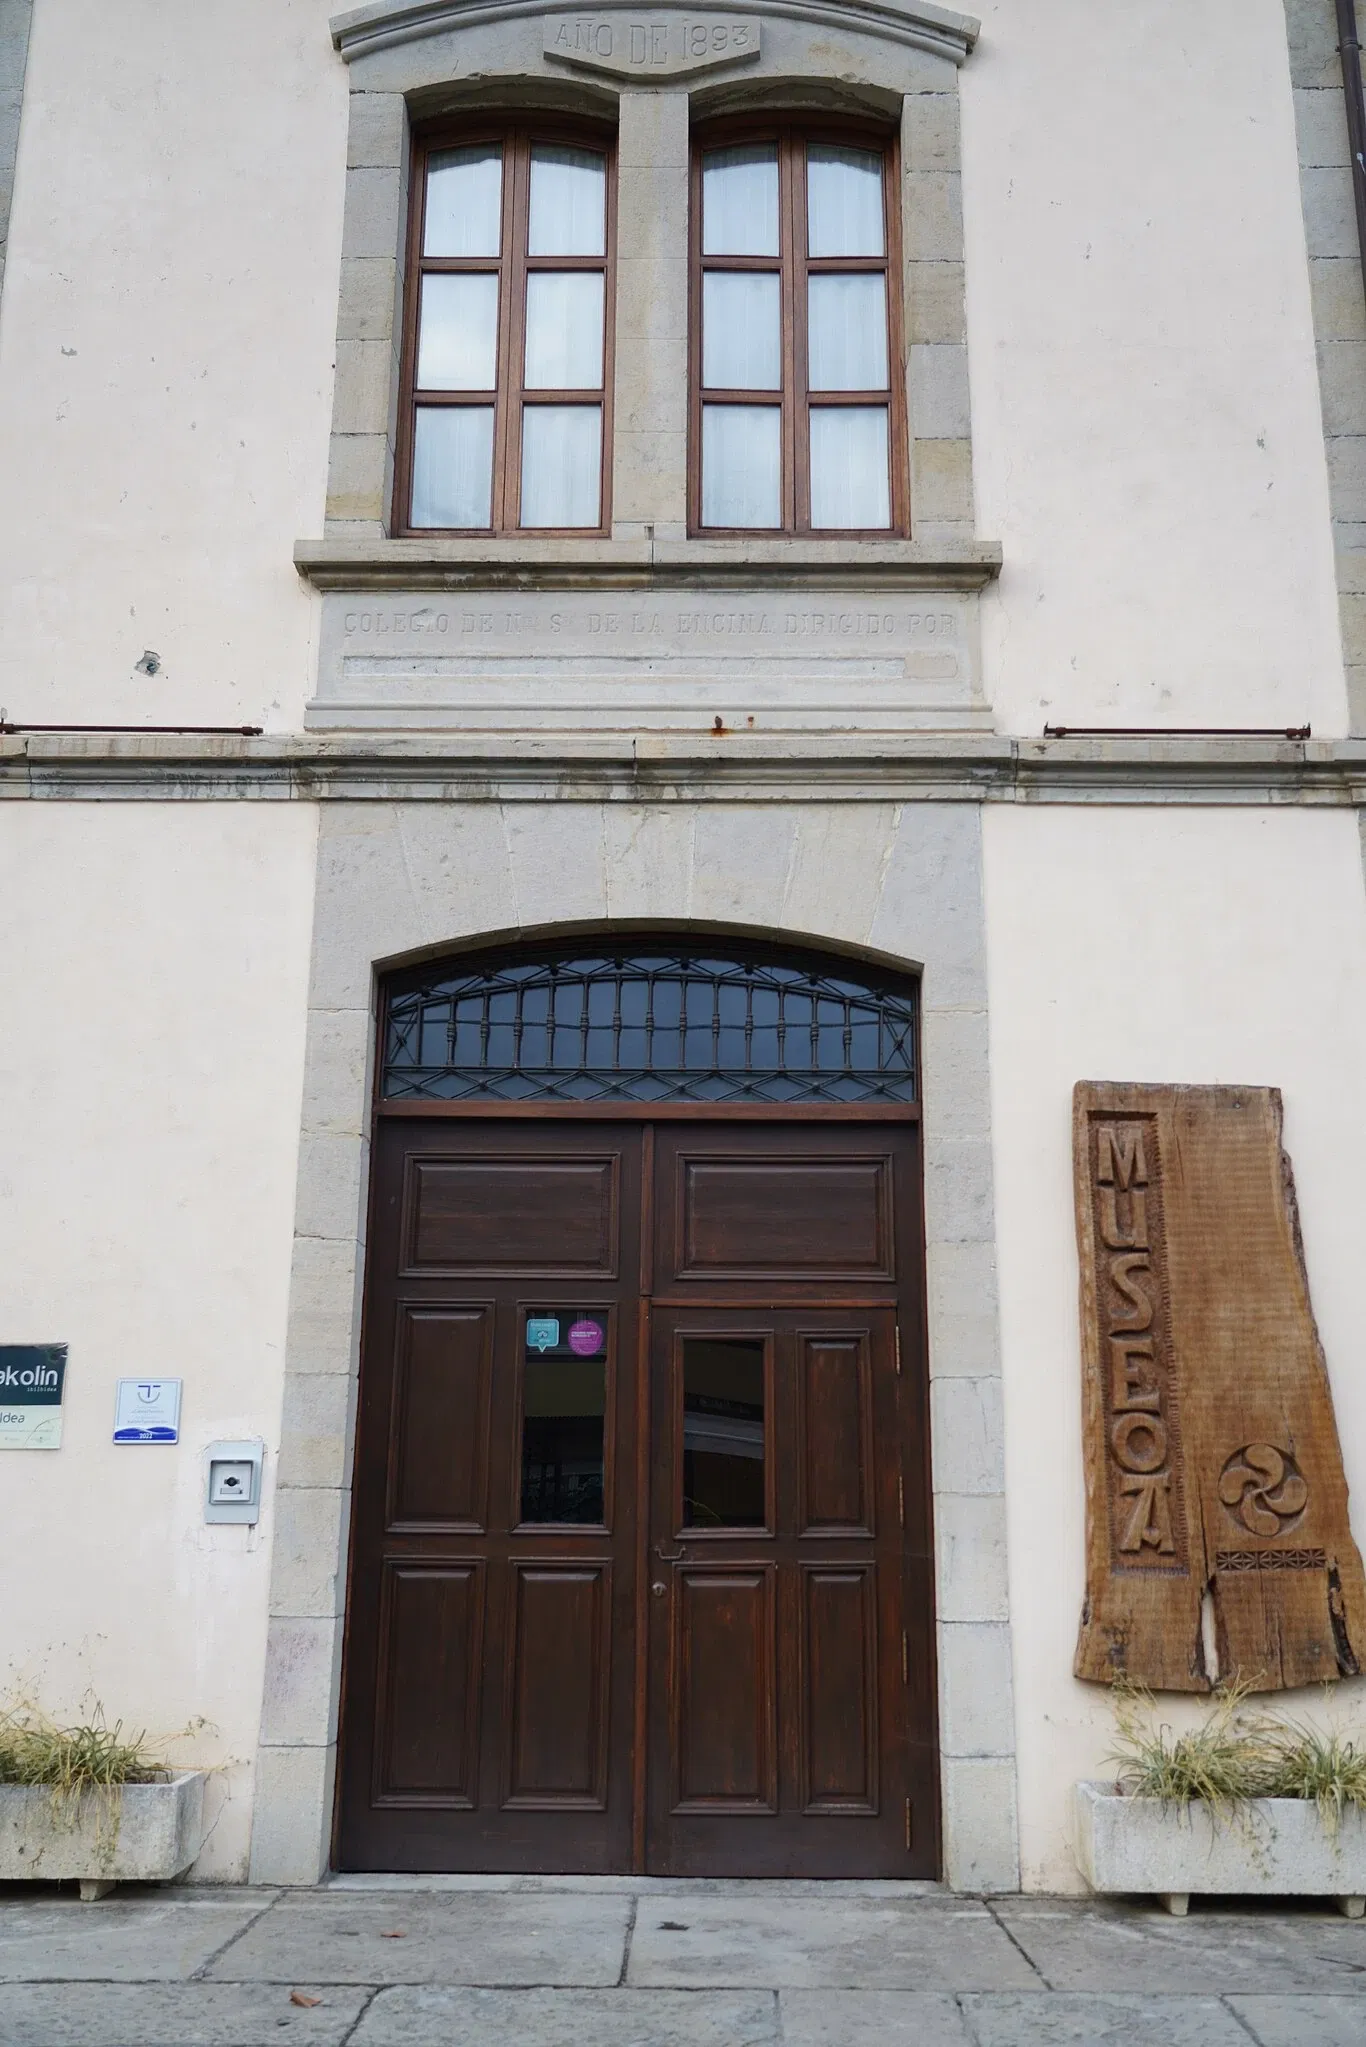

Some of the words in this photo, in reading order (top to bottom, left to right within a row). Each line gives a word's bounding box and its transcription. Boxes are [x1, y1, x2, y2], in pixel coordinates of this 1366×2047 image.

[555, 18, 613, 57] AÑO
[629, 24, 668, 65] DE
[461, 613, 493, 633] DE
[588, 612, 619, 634] DE
[632, 612, 663, 634] LA
[676, 612, 774, 635] ENCINA
[784, 613, 897, 635] DIRIGIDO
[907, 613, 957, 636] POR
[1098, 1126, 1174, 1556] MUSEOA
